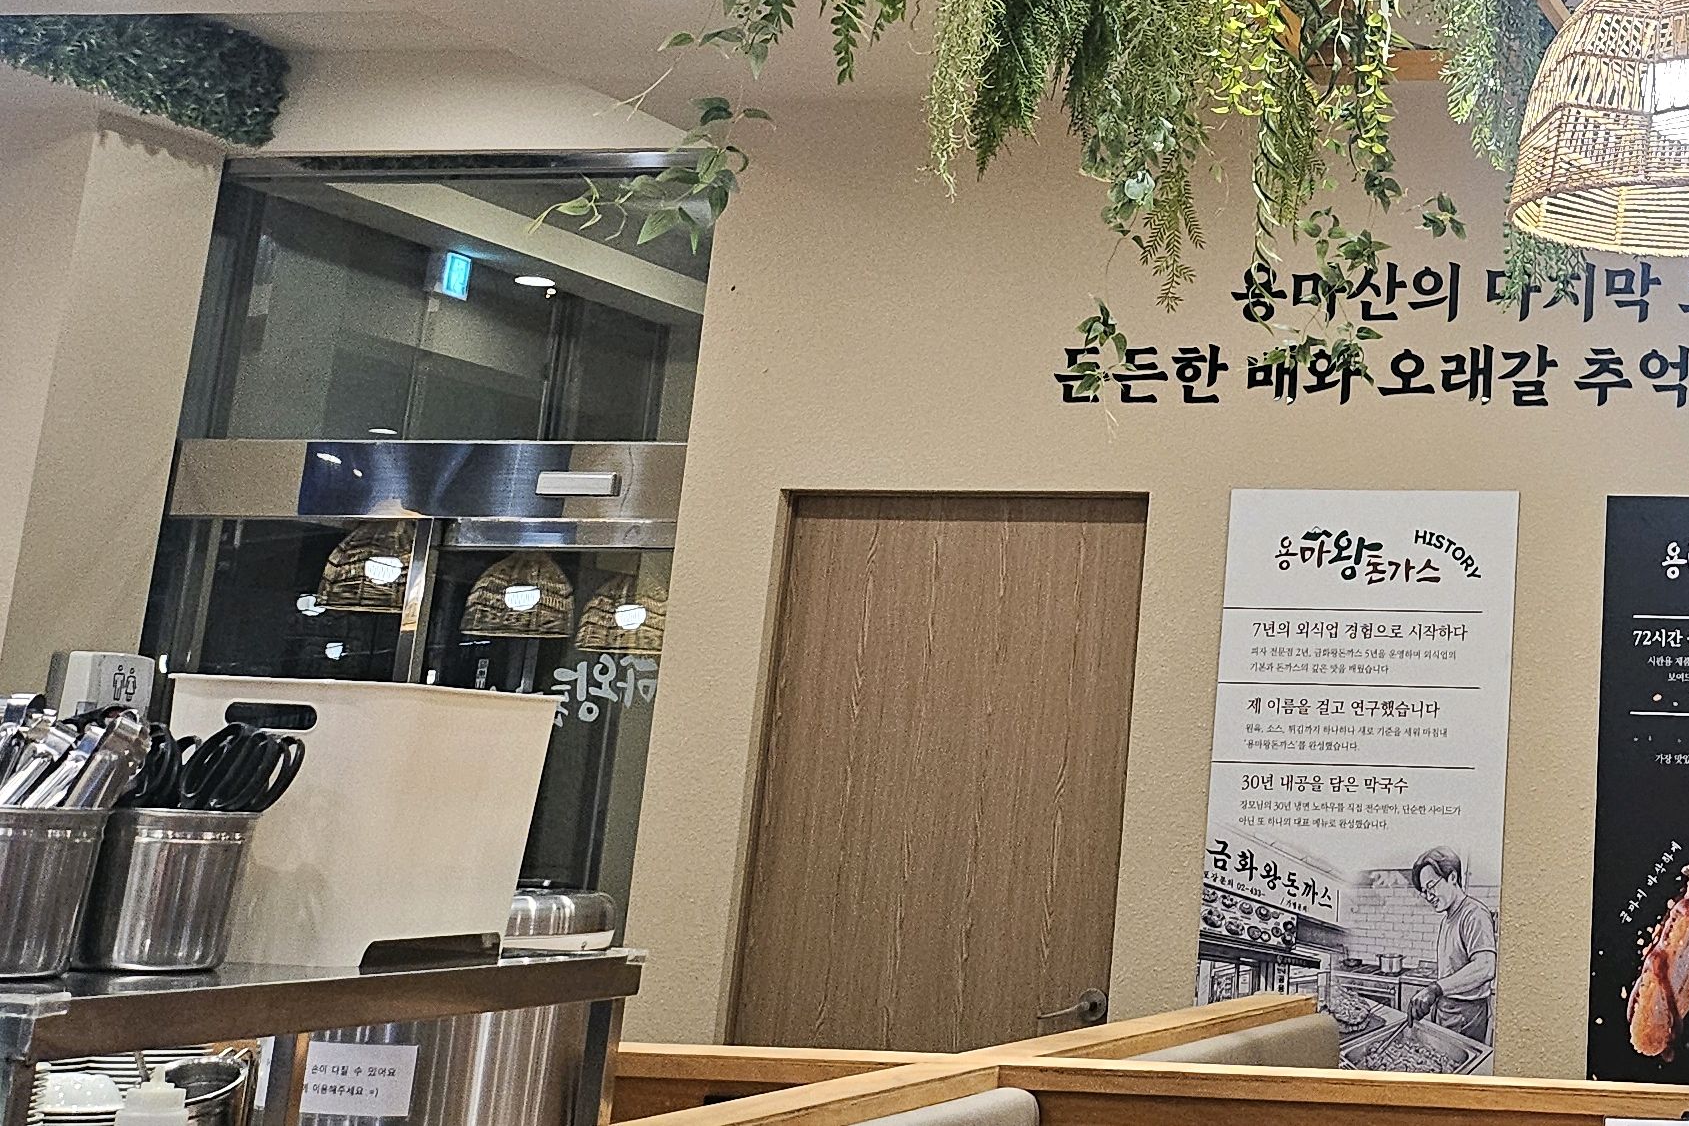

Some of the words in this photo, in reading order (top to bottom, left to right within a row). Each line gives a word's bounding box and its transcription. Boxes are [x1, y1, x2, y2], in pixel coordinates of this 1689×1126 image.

[1231, 261, 1461, 323] 용마산의
[1485, 261, 1662, 323] 마지막
[1054, 343, 1229, 404] 든든한
[1247, 344, 1370, 406] 배와
[1377, 343, 1559, 406] 오래갈
[1413, 529, 1482, 580] HISTORY
[1252, 621, 1291, 637] 7년의
[1295, 621, 1339, 638] 외식업
[1344, 622, 1404, 639] 경험으로
[1408, 624, 1469, 641] 시작하다
[1632, 629, 1684, 647] 72시간
[1246, 698, 1262, 714] 제
[1267, 698, 1312, 715] 이름을
[1315, 699, 1346, 715] 걸고
[1350, 700, 1441, 718] 연구했습니다
[1241, 774, 1274, 790] 30년
[1280, 775, 1325, 792] 내공을
[1329, 776, 1360, 792] 담은
[1363, 777, 1409, 794] 막국수
[1205, 838, 1333, 909] 금화왕돈까스
[354, 1066, 363, 1077] 수
